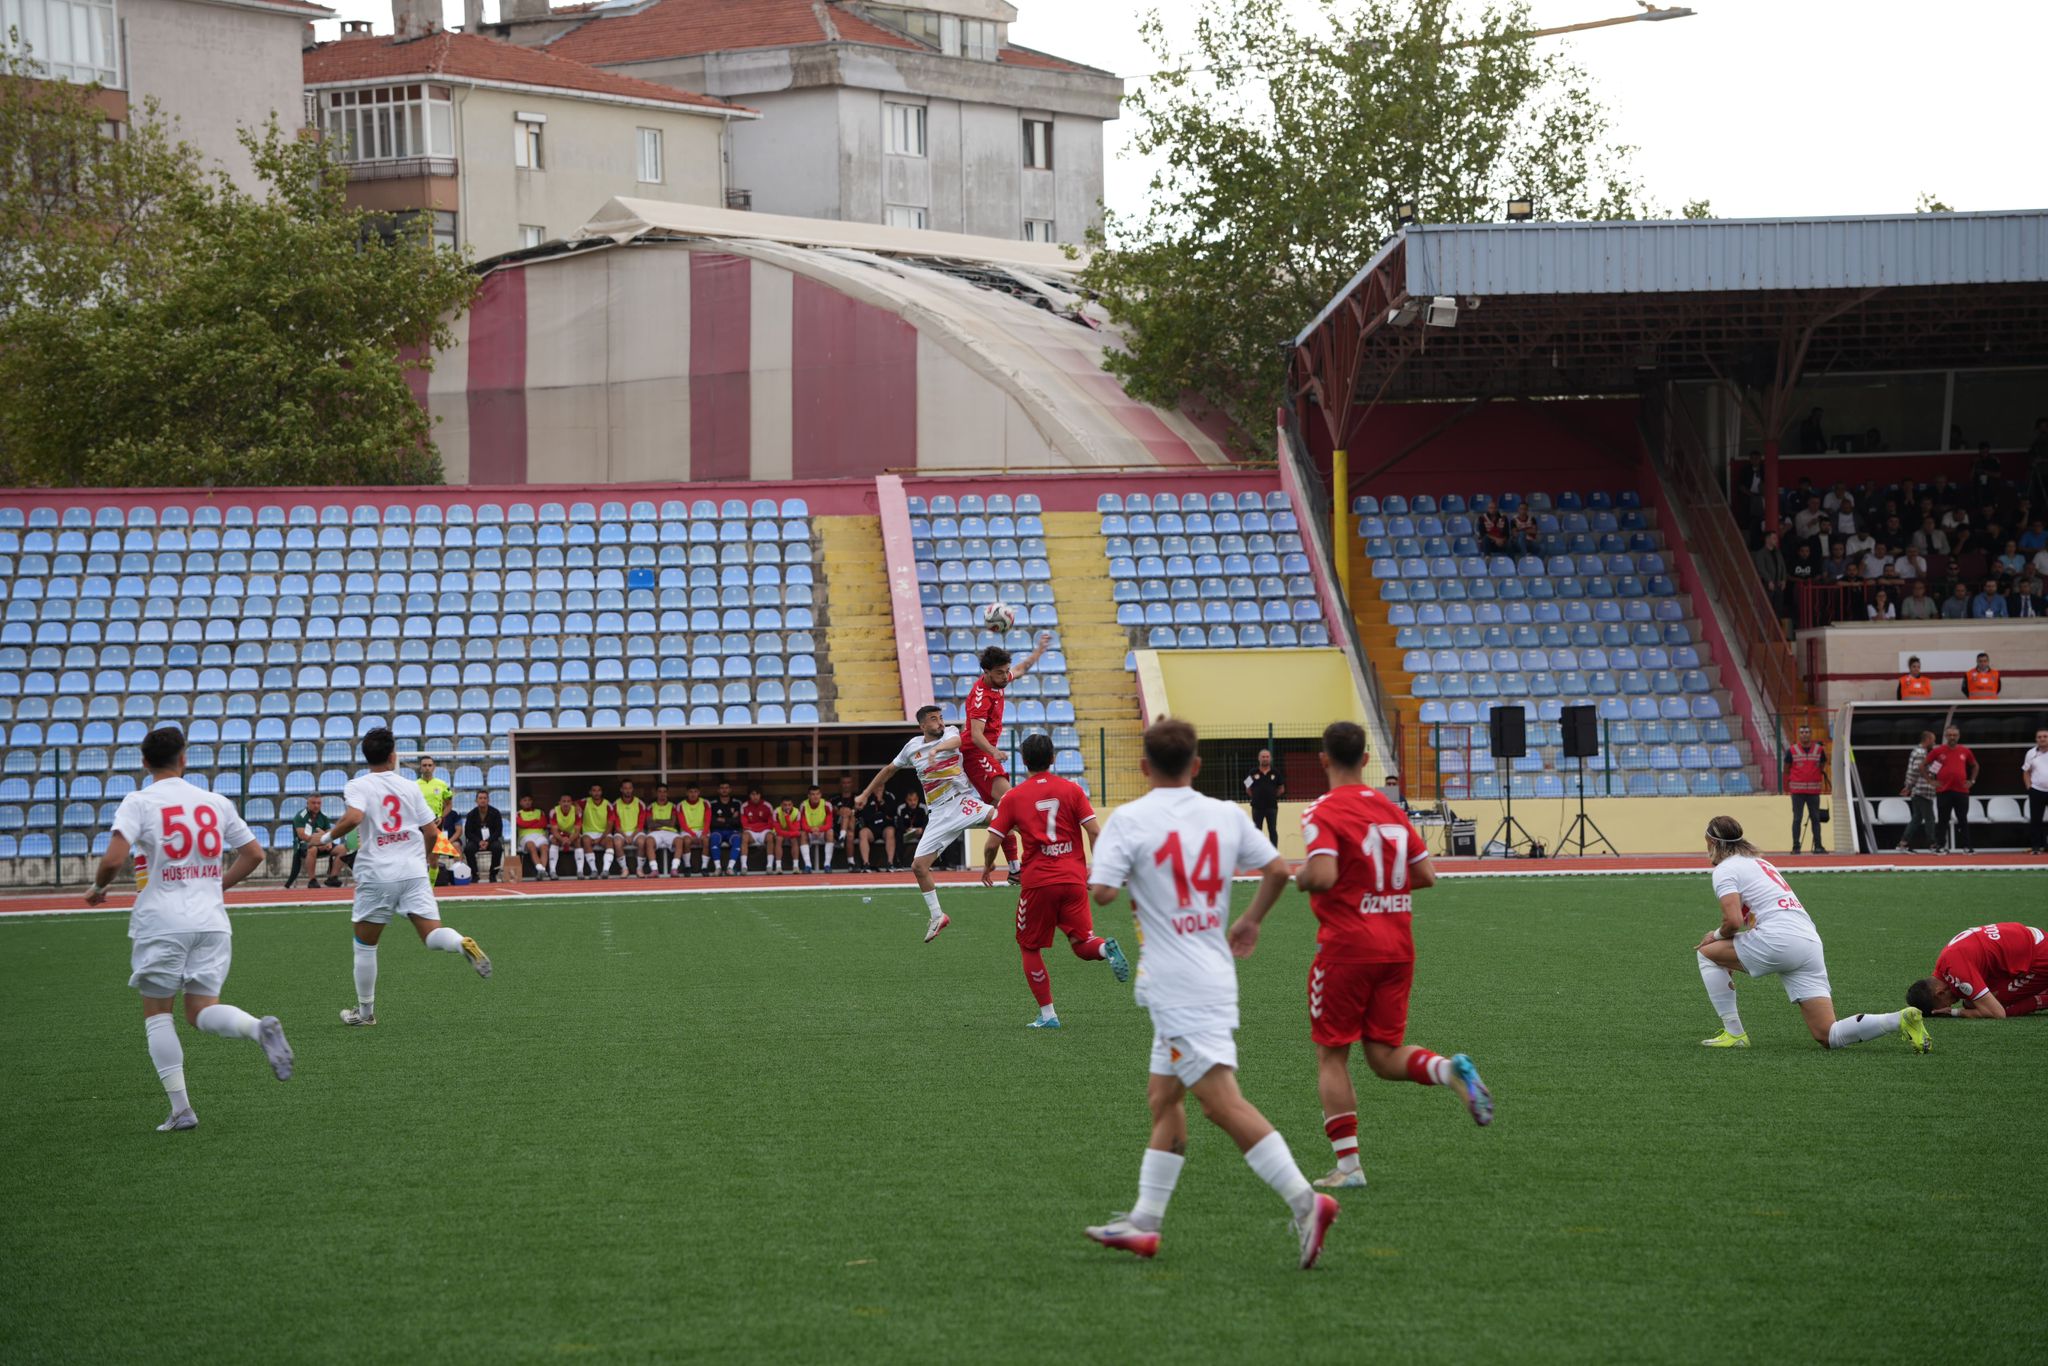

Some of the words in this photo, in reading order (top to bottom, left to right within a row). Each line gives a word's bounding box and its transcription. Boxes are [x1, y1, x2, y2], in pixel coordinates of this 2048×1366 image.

[160, 804, 222, 860] 58
[377, 831, 410, 846] BURAK
[382, 794, 402, 833] 3
[1035, 798, 1060, 842] 7
[1153, 830, 1224, 908] 14
[1361, 823, 1409, 892] 17
